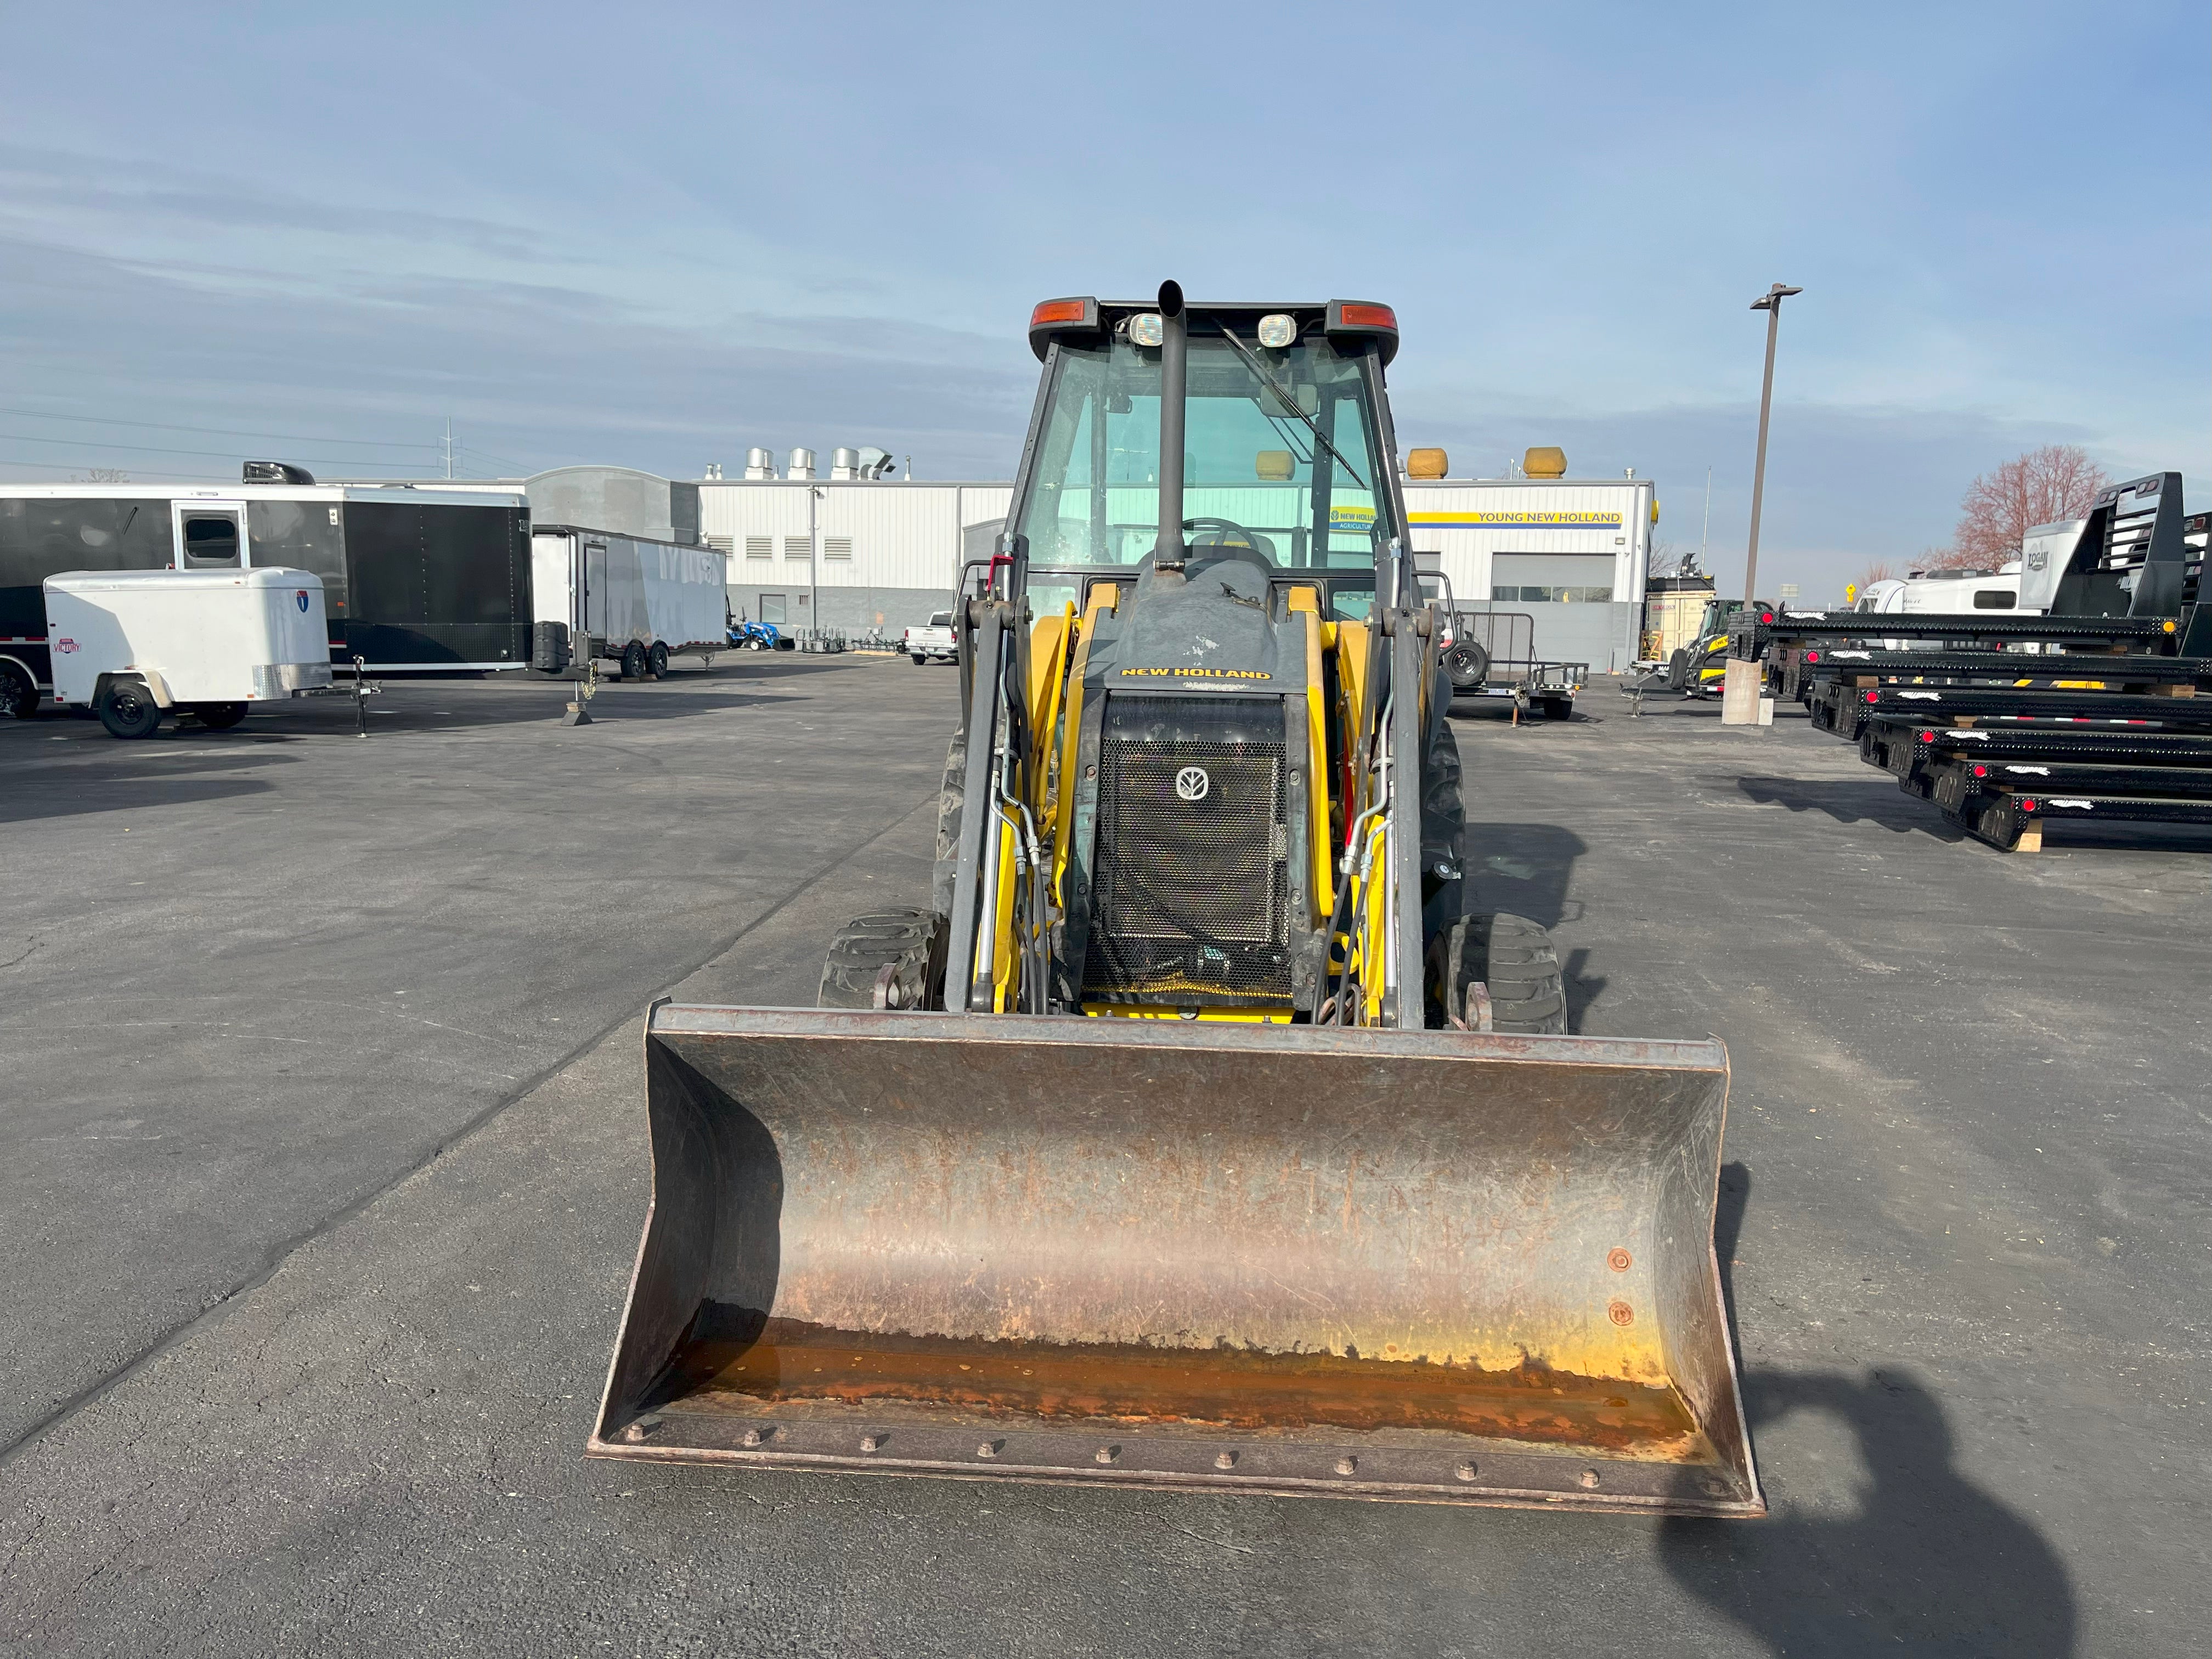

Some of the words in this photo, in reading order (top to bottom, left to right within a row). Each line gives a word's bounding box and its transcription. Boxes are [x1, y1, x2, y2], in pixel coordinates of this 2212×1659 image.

[1478, 513, 1523, 522] YOUNG
[1527, 513, 1555, 522] NEW
[1559, 513, 1620, 522] HOLLAND
[2028, 551, 2049, 566] LOGAN
[1174, 668, 1271, 680] HOLLAND
